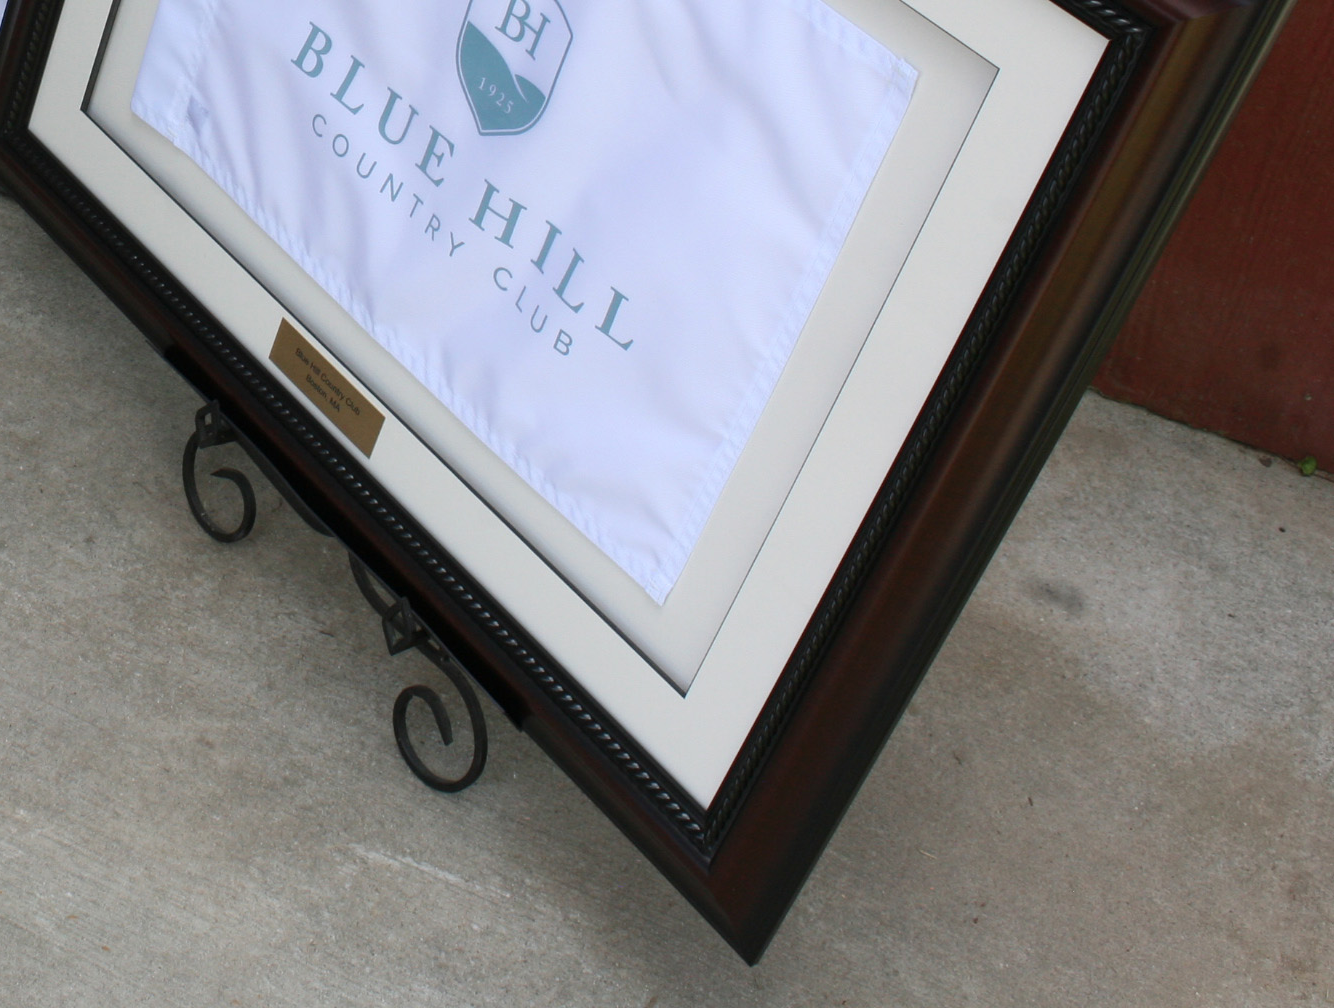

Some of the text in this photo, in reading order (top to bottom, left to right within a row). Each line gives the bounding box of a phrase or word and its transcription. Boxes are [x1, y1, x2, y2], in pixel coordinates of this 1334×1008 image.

[477, 76, 515, 115] 1925
[290, 21, 634, 351] BLUE HILL
[312, 113, 574, 356] COUNTRY CLUB
[295, 347, 309, 366] Blue
[321, 373, 345, 401] Country
[346, 397, 361, 416] Club
[329, 398, 341, 413] MA
